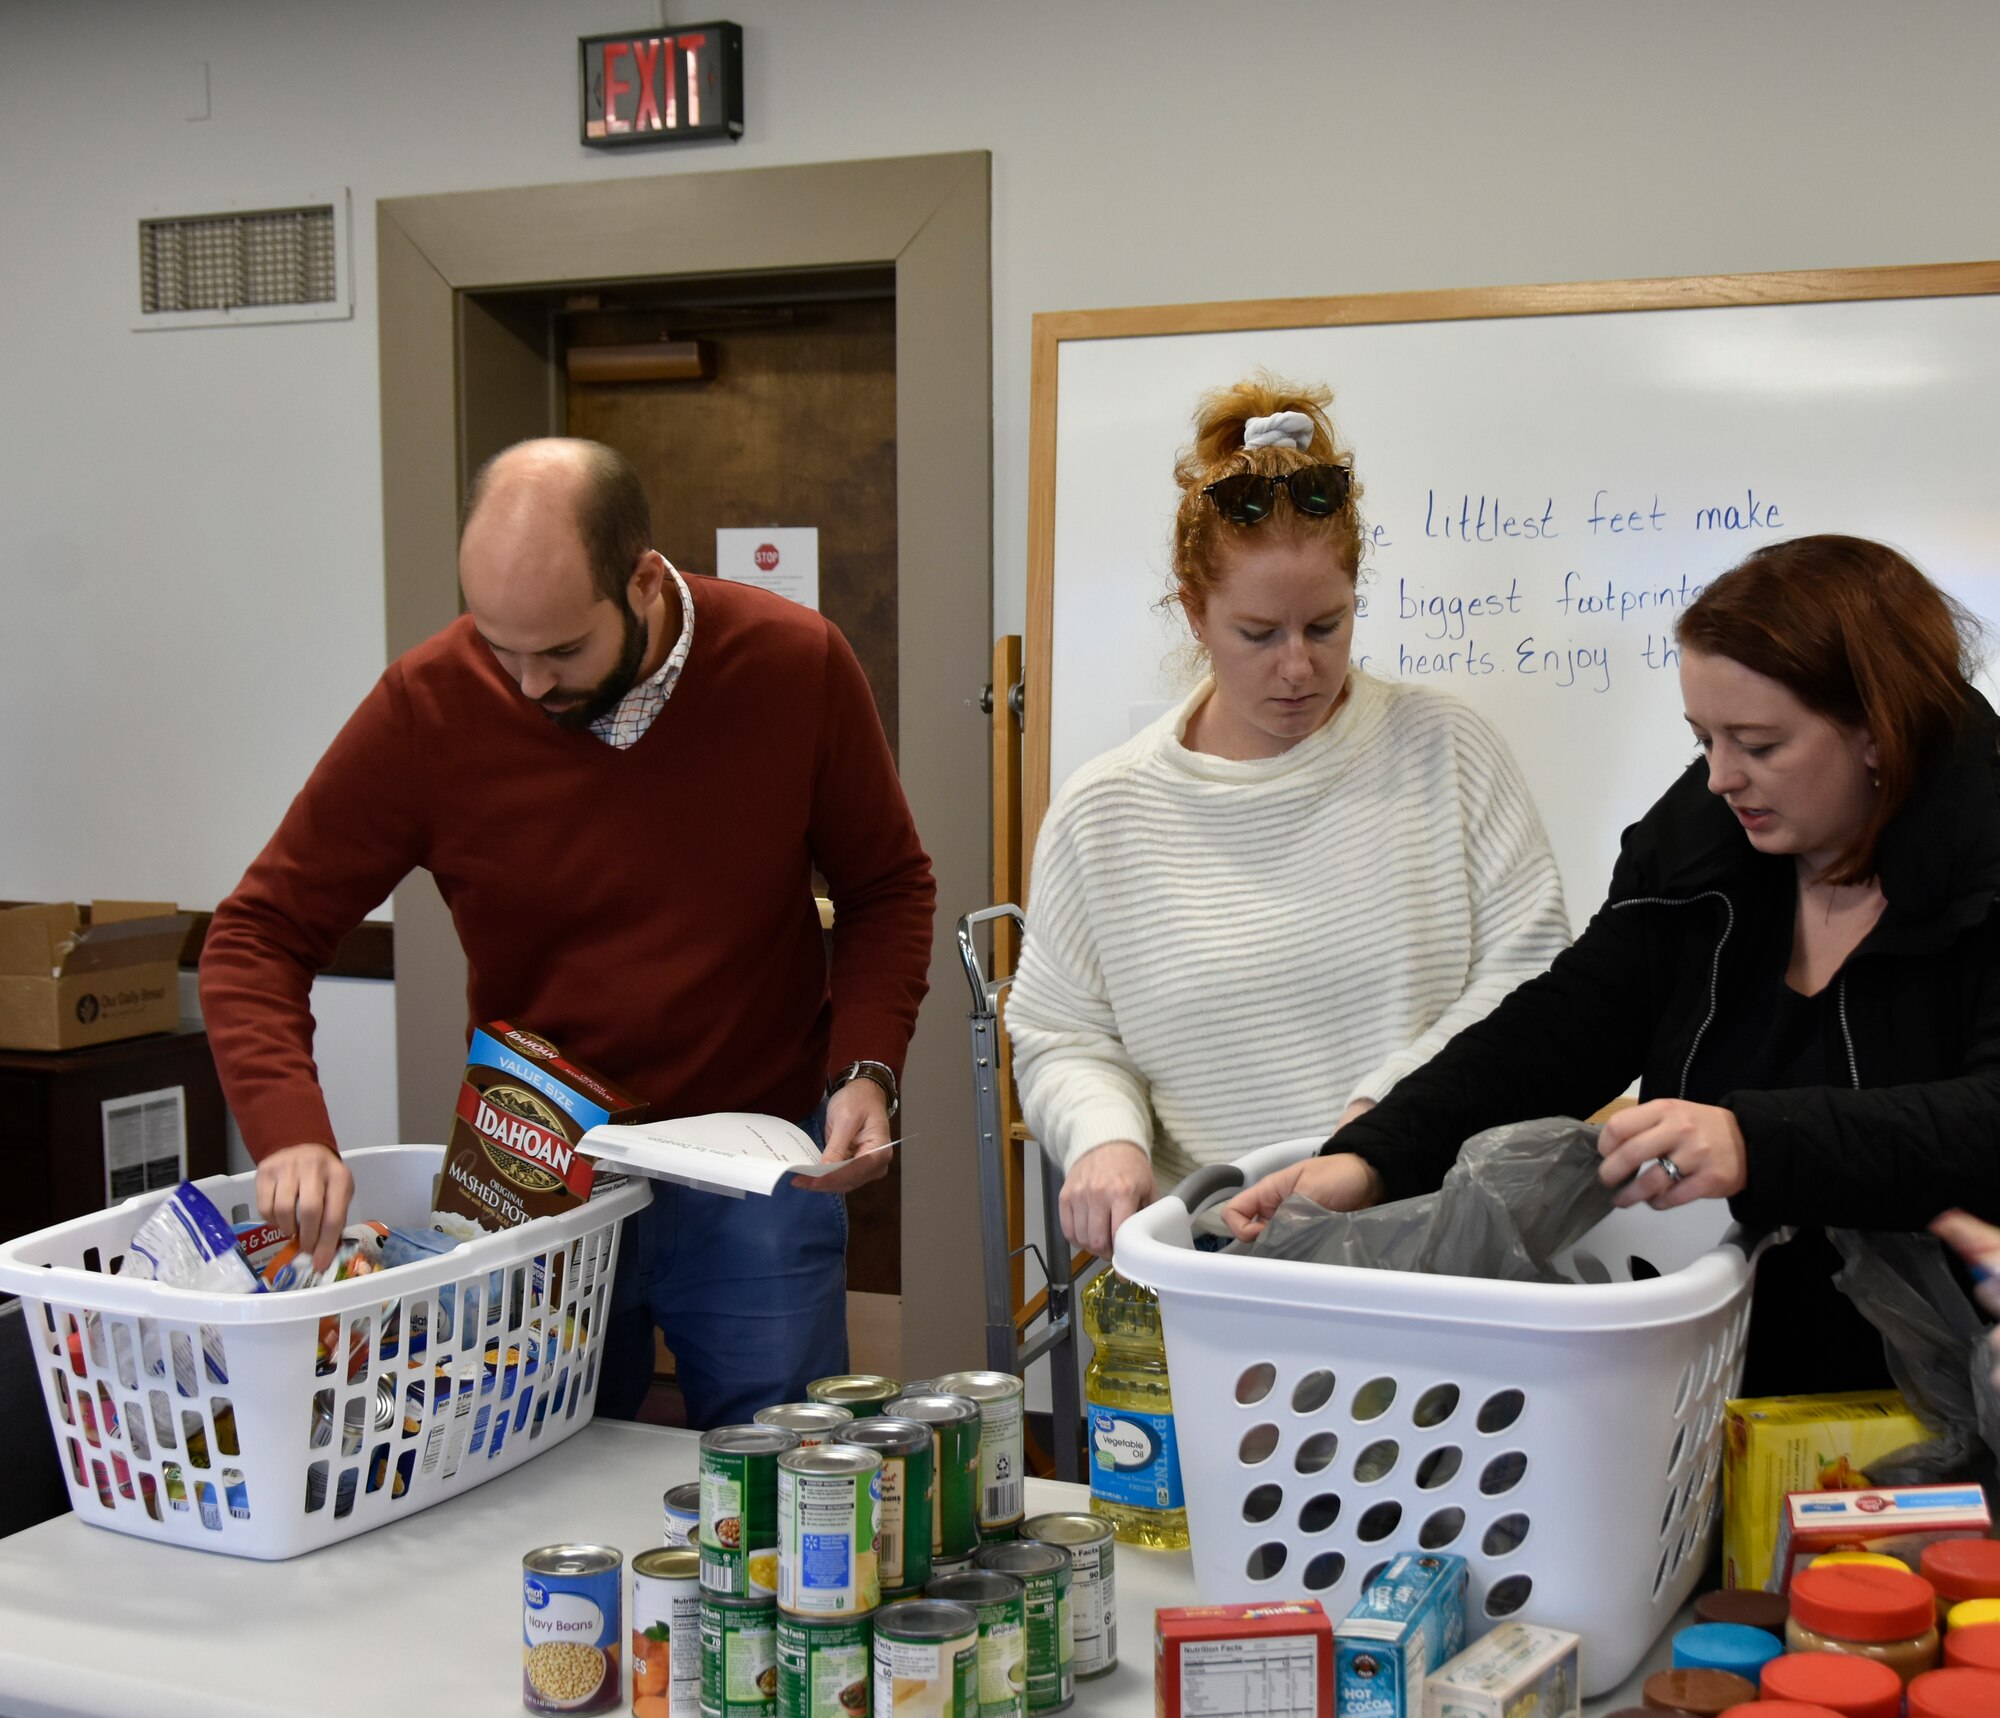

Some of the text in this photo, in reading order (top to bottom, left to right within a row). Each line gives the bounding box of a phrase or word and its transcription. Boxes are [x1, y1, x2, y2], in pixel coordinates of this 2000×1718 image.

[603, 34, 706, 133] EXIT
[1425, 489, 1559, 542] littlest
[1588, 490, 1666, 534] feet
[1696, 489, 1784, 530] make
[755, 551, 779, 564] STOP
[1399, 578, 1522, 640] biggest
[1517, 636, 1610, 693] Enjoy
[1642, 634, 1679, 669] th
[505, 1030, 558, 1059] IDAHOAN
[499, 1056, 574, 1112] VALUE SIZE
[474, 1099, 574, 1176] IDAHOAN
[449, 1162, 533, 1225] MASHED POT
[490, 1179, 524, 1208] ORIGINAL
[1102, 1434, 1144, 1450] Vegetable
[1132, 1449, 1144, 1459] Oil
[1078, 1547, 1099, 1557] Facts
[1089, 1571, 1099, 1579] 90
[525, 1582, 544, 1599] Great
[1035, 1578, 1053, 1588] Facts
[706, 1609, 721, 1620] Facts
[528, 1615, 593, 1632] Navy Beans
[711, 1636, 721, 1646] 70
[789, 1628, 806, 1640] Facts
[1184, 1644, 1243, 1654] Nutrition Facts
[796, 1657, 806, 1667] 15
[882, 1667, 892, 1678] 60
[1344, 1688, 1372, 1700] HOT
[1347, 1698, 1392, 1713] COCOA
